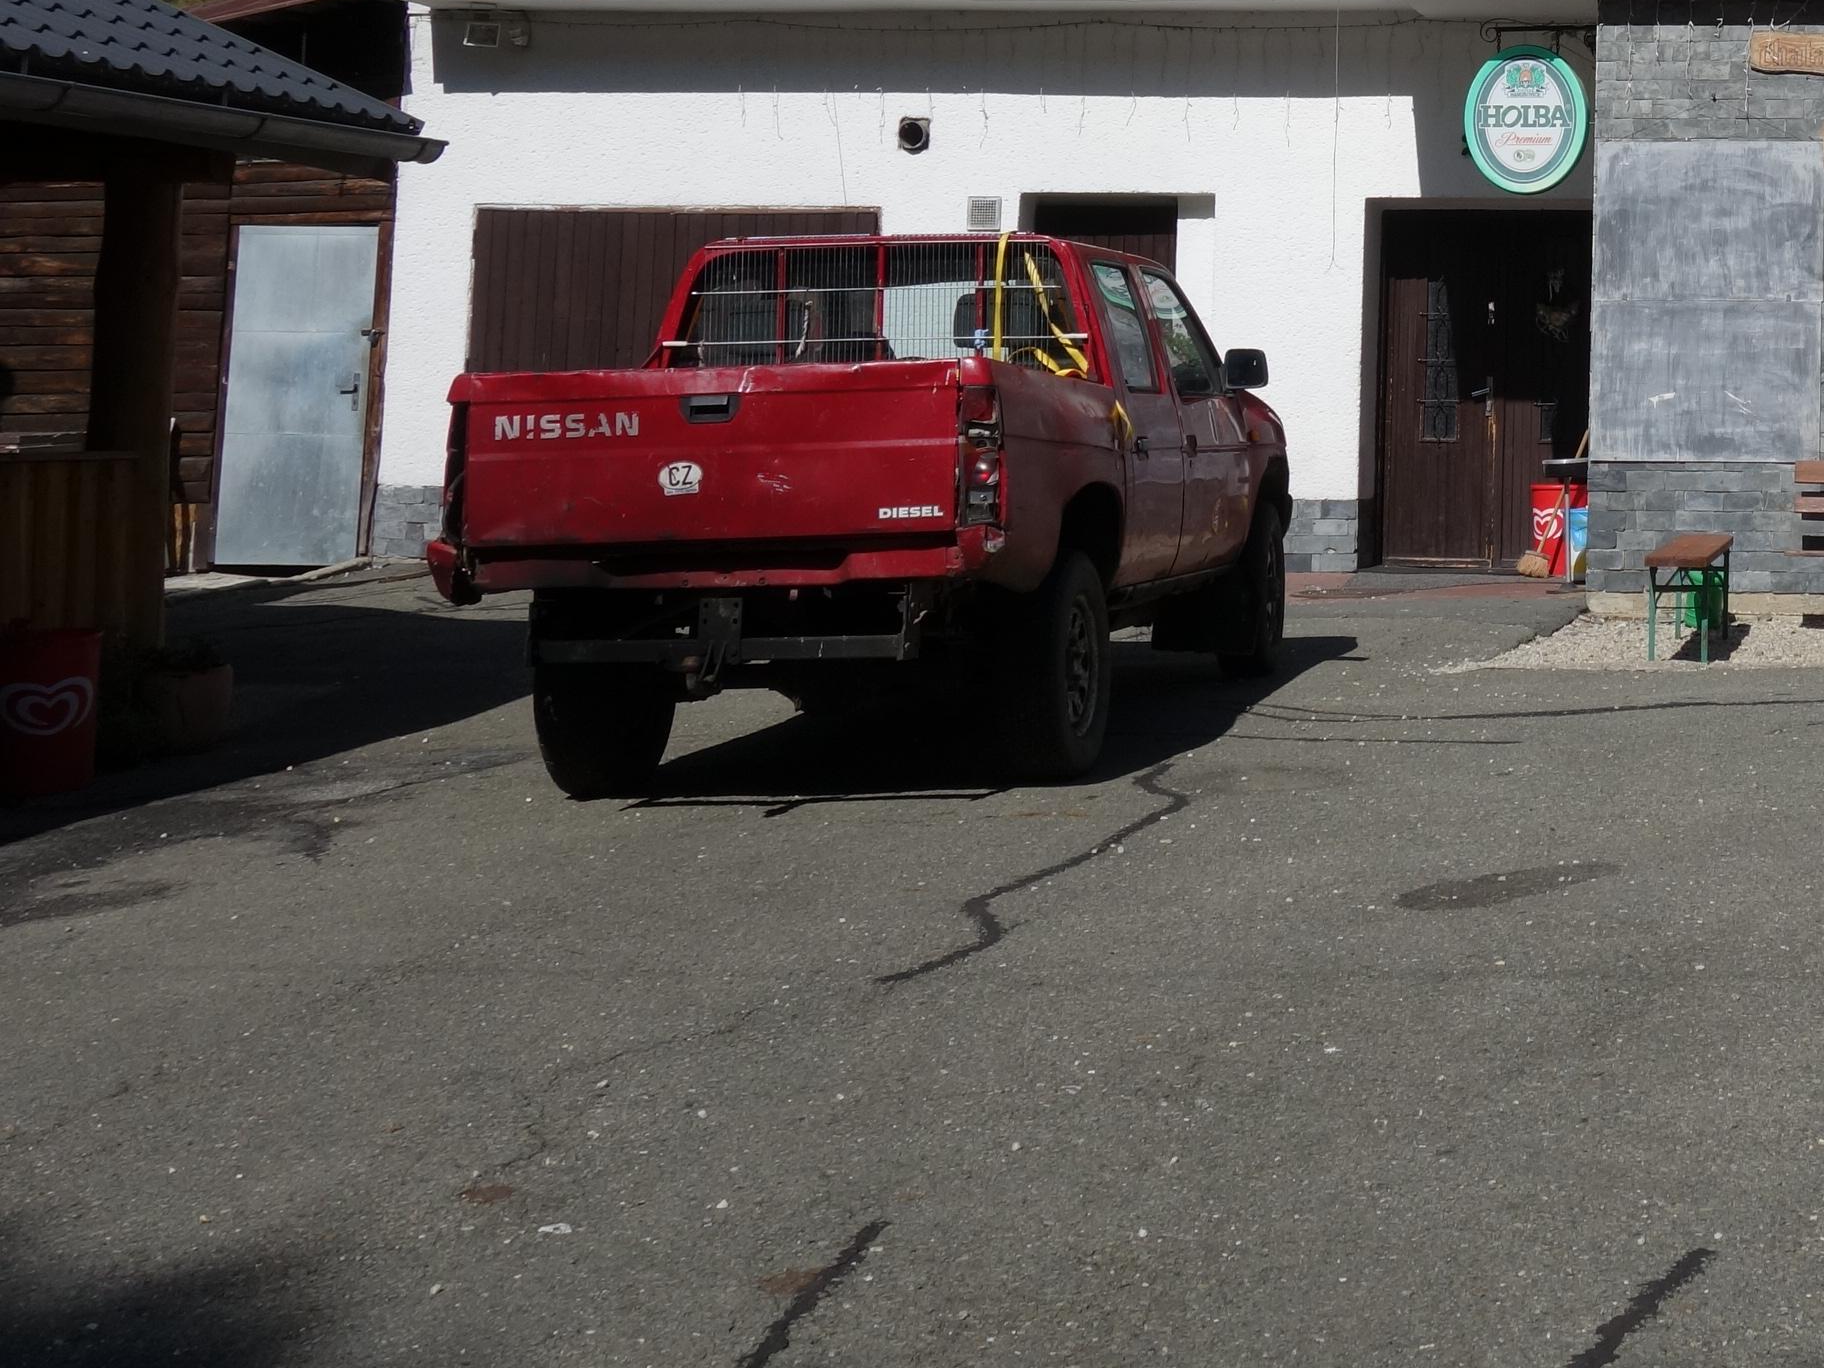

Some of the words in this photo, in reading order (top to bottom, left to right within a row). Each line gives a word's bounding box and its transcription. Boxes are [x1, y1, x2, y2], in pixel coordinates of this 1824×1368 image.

[1480, 105, 1571, 128] HOLBA
[1495, 132, 1552, 148] Premium
[494, 411, 640, 440] NISSAN
[669, 465, 693, 486] CZ
[879, 506, 944, 519] DIESEL
